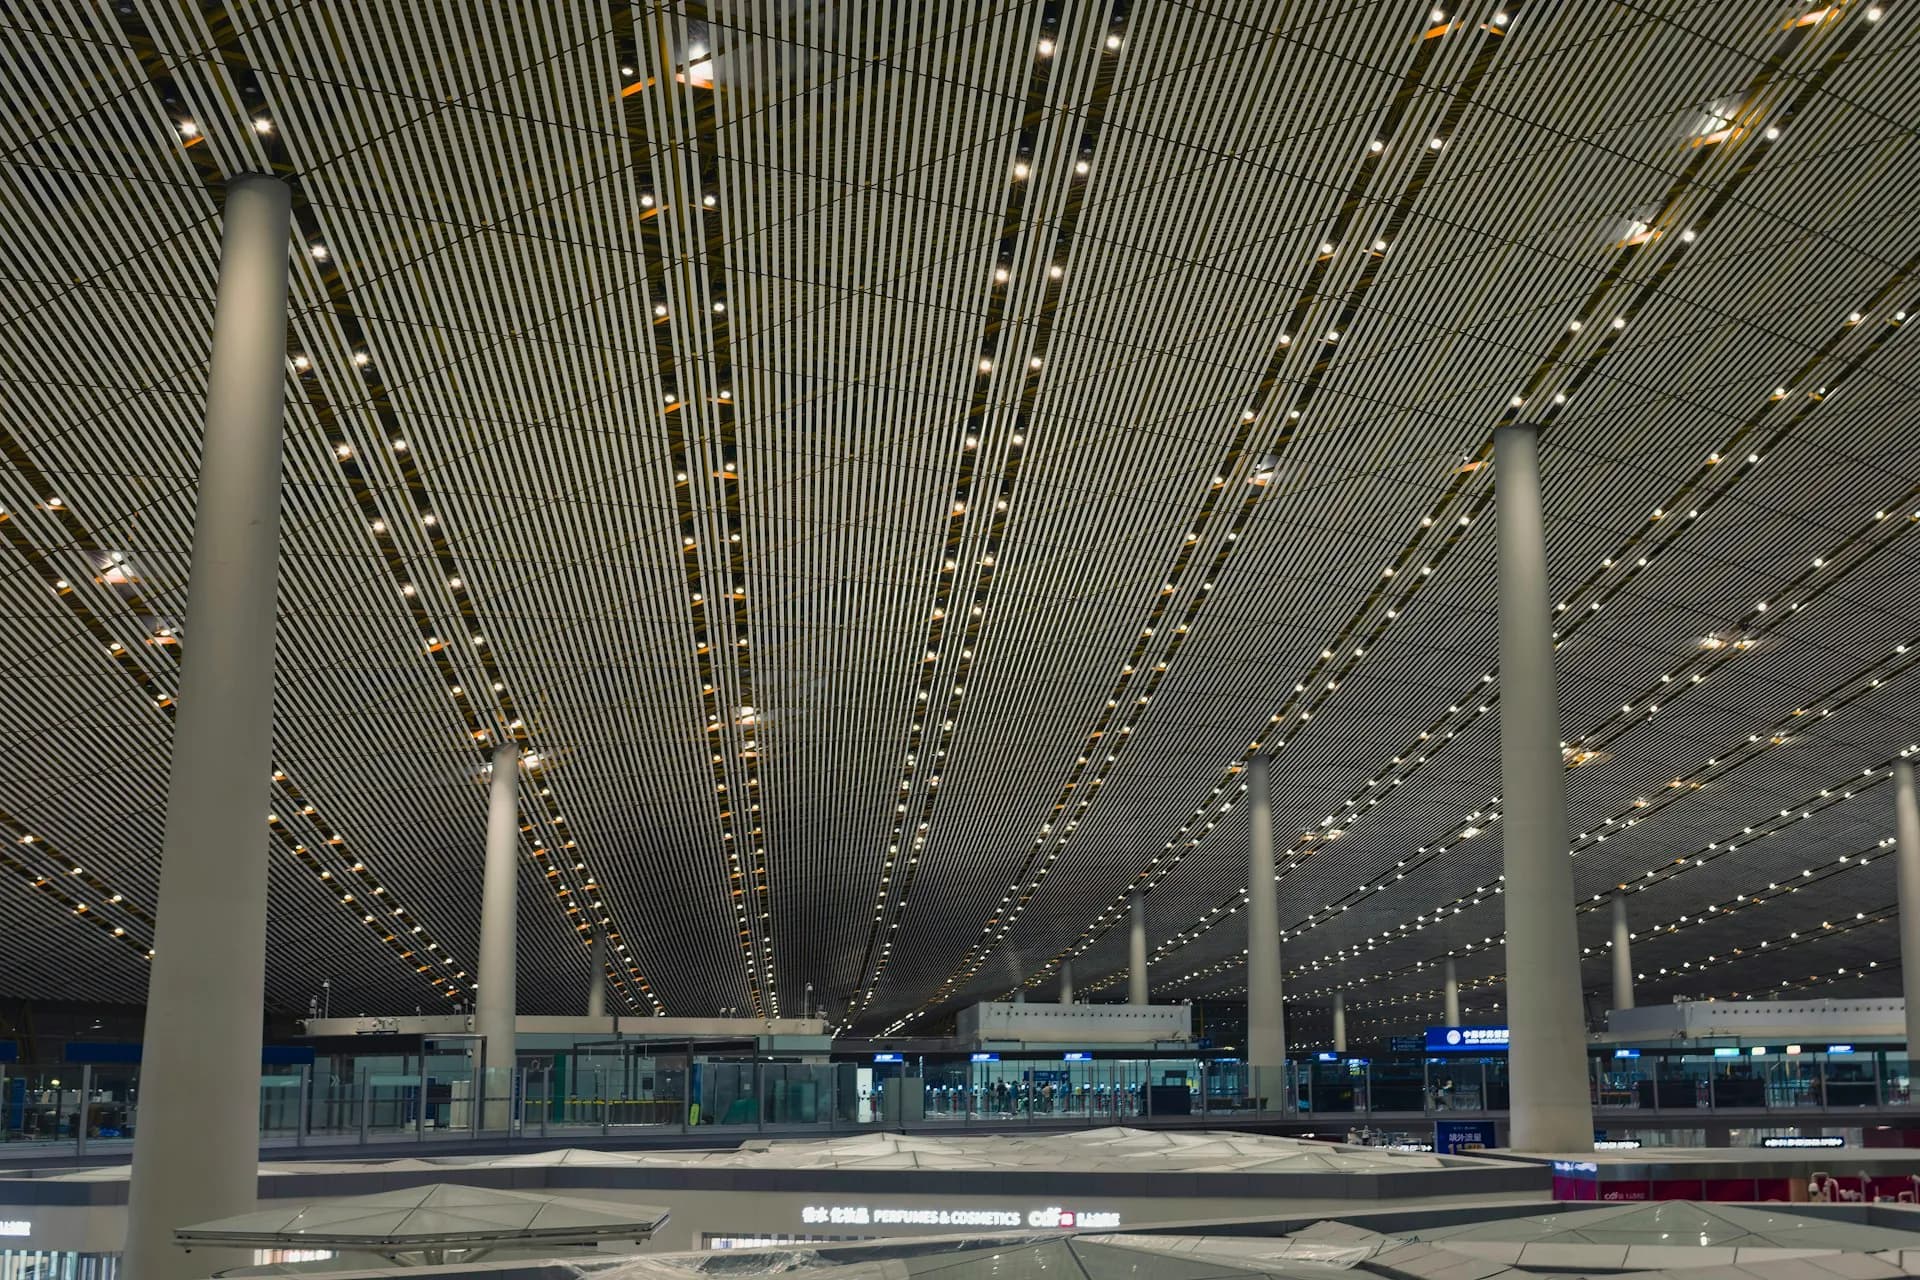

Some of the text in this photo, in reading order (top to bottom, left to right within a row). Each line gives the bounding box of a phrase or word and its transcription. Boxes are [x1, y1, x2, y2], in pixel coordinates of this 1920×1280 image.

[1448, 1132, 1482, 1142] 境外流量
[830, 1207, 869, 1224] 化妆品
[873, 1210, 938, 1224] PERFUMES
[939, 1211, 950, 1224] &
[950, 1211, 1021, 1226] COSMETICS
